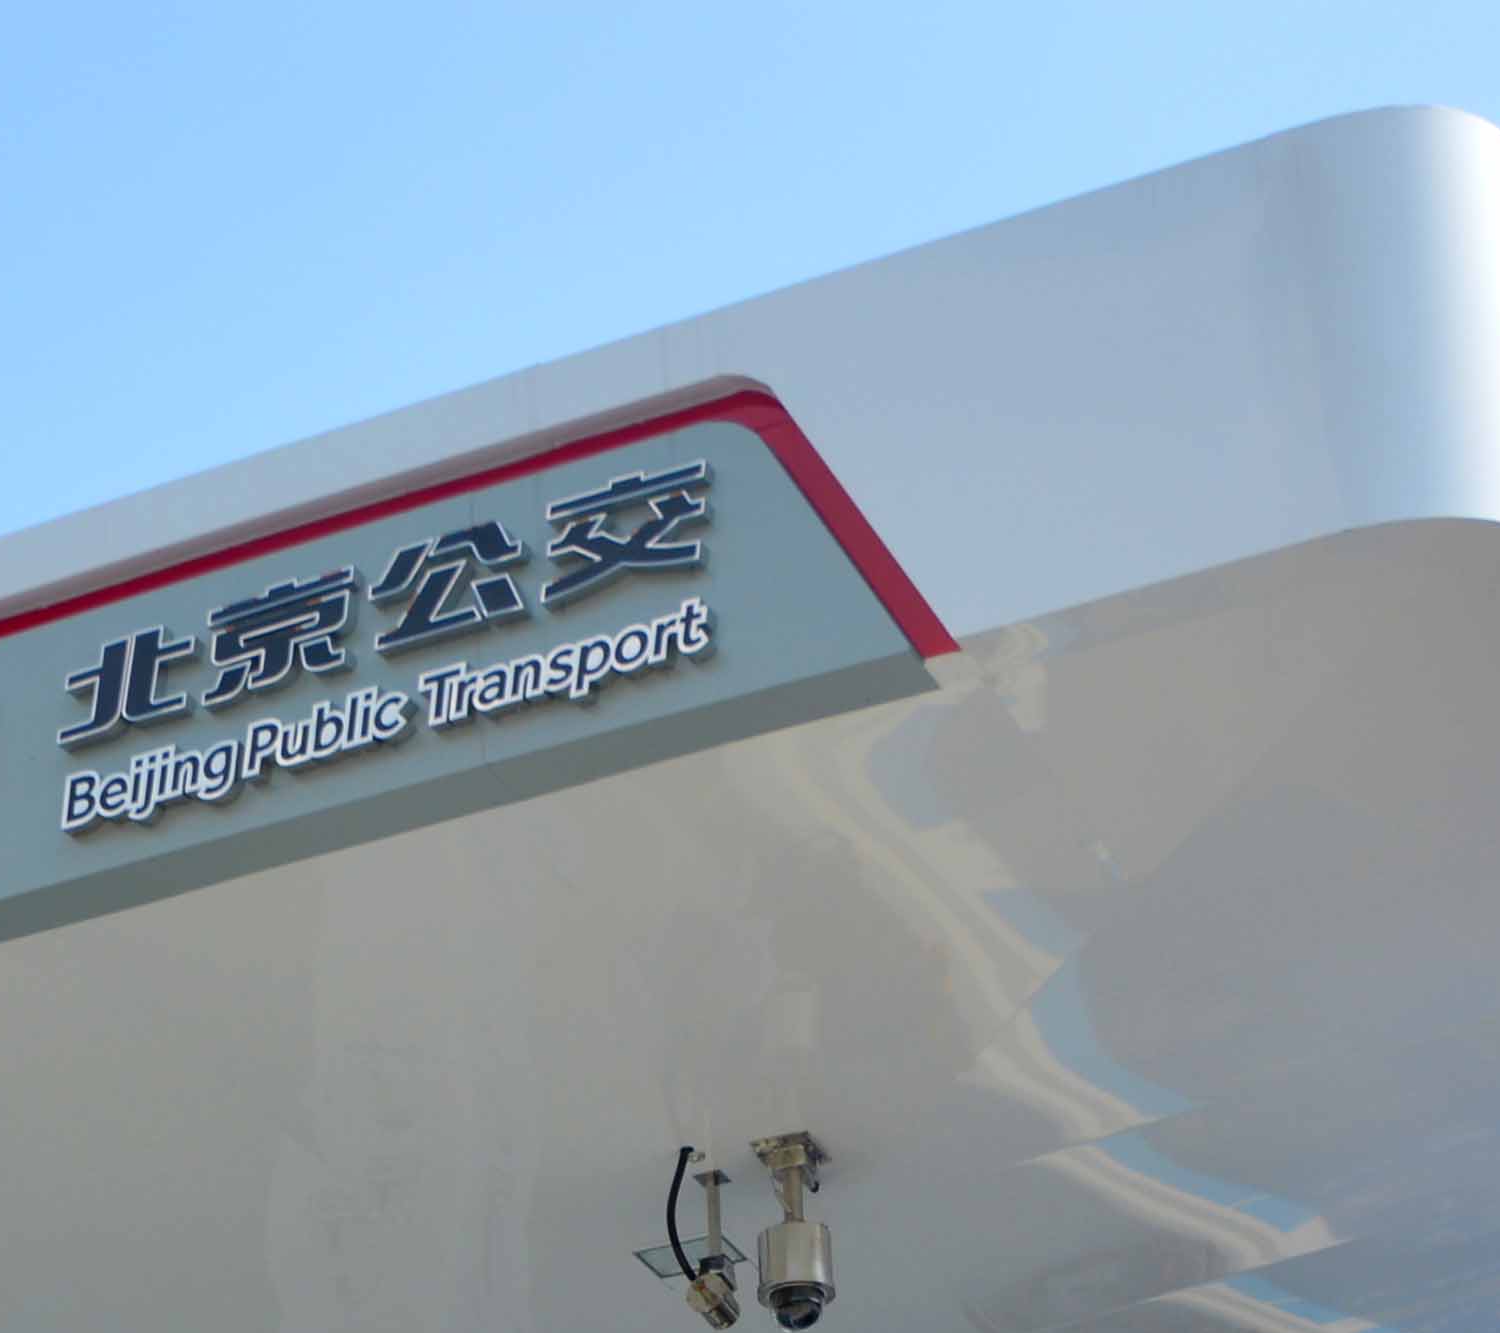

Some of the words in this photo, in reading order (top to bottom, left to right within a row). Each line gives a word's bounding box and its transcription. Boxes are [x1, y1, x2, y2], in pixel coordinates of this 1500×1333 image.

[56, 458, 710, 748] 北京公交
[61, 738, 239, 832] Beijing
[243, 685, 406, 780] Public
[421, 598, 710, 727] Transport
